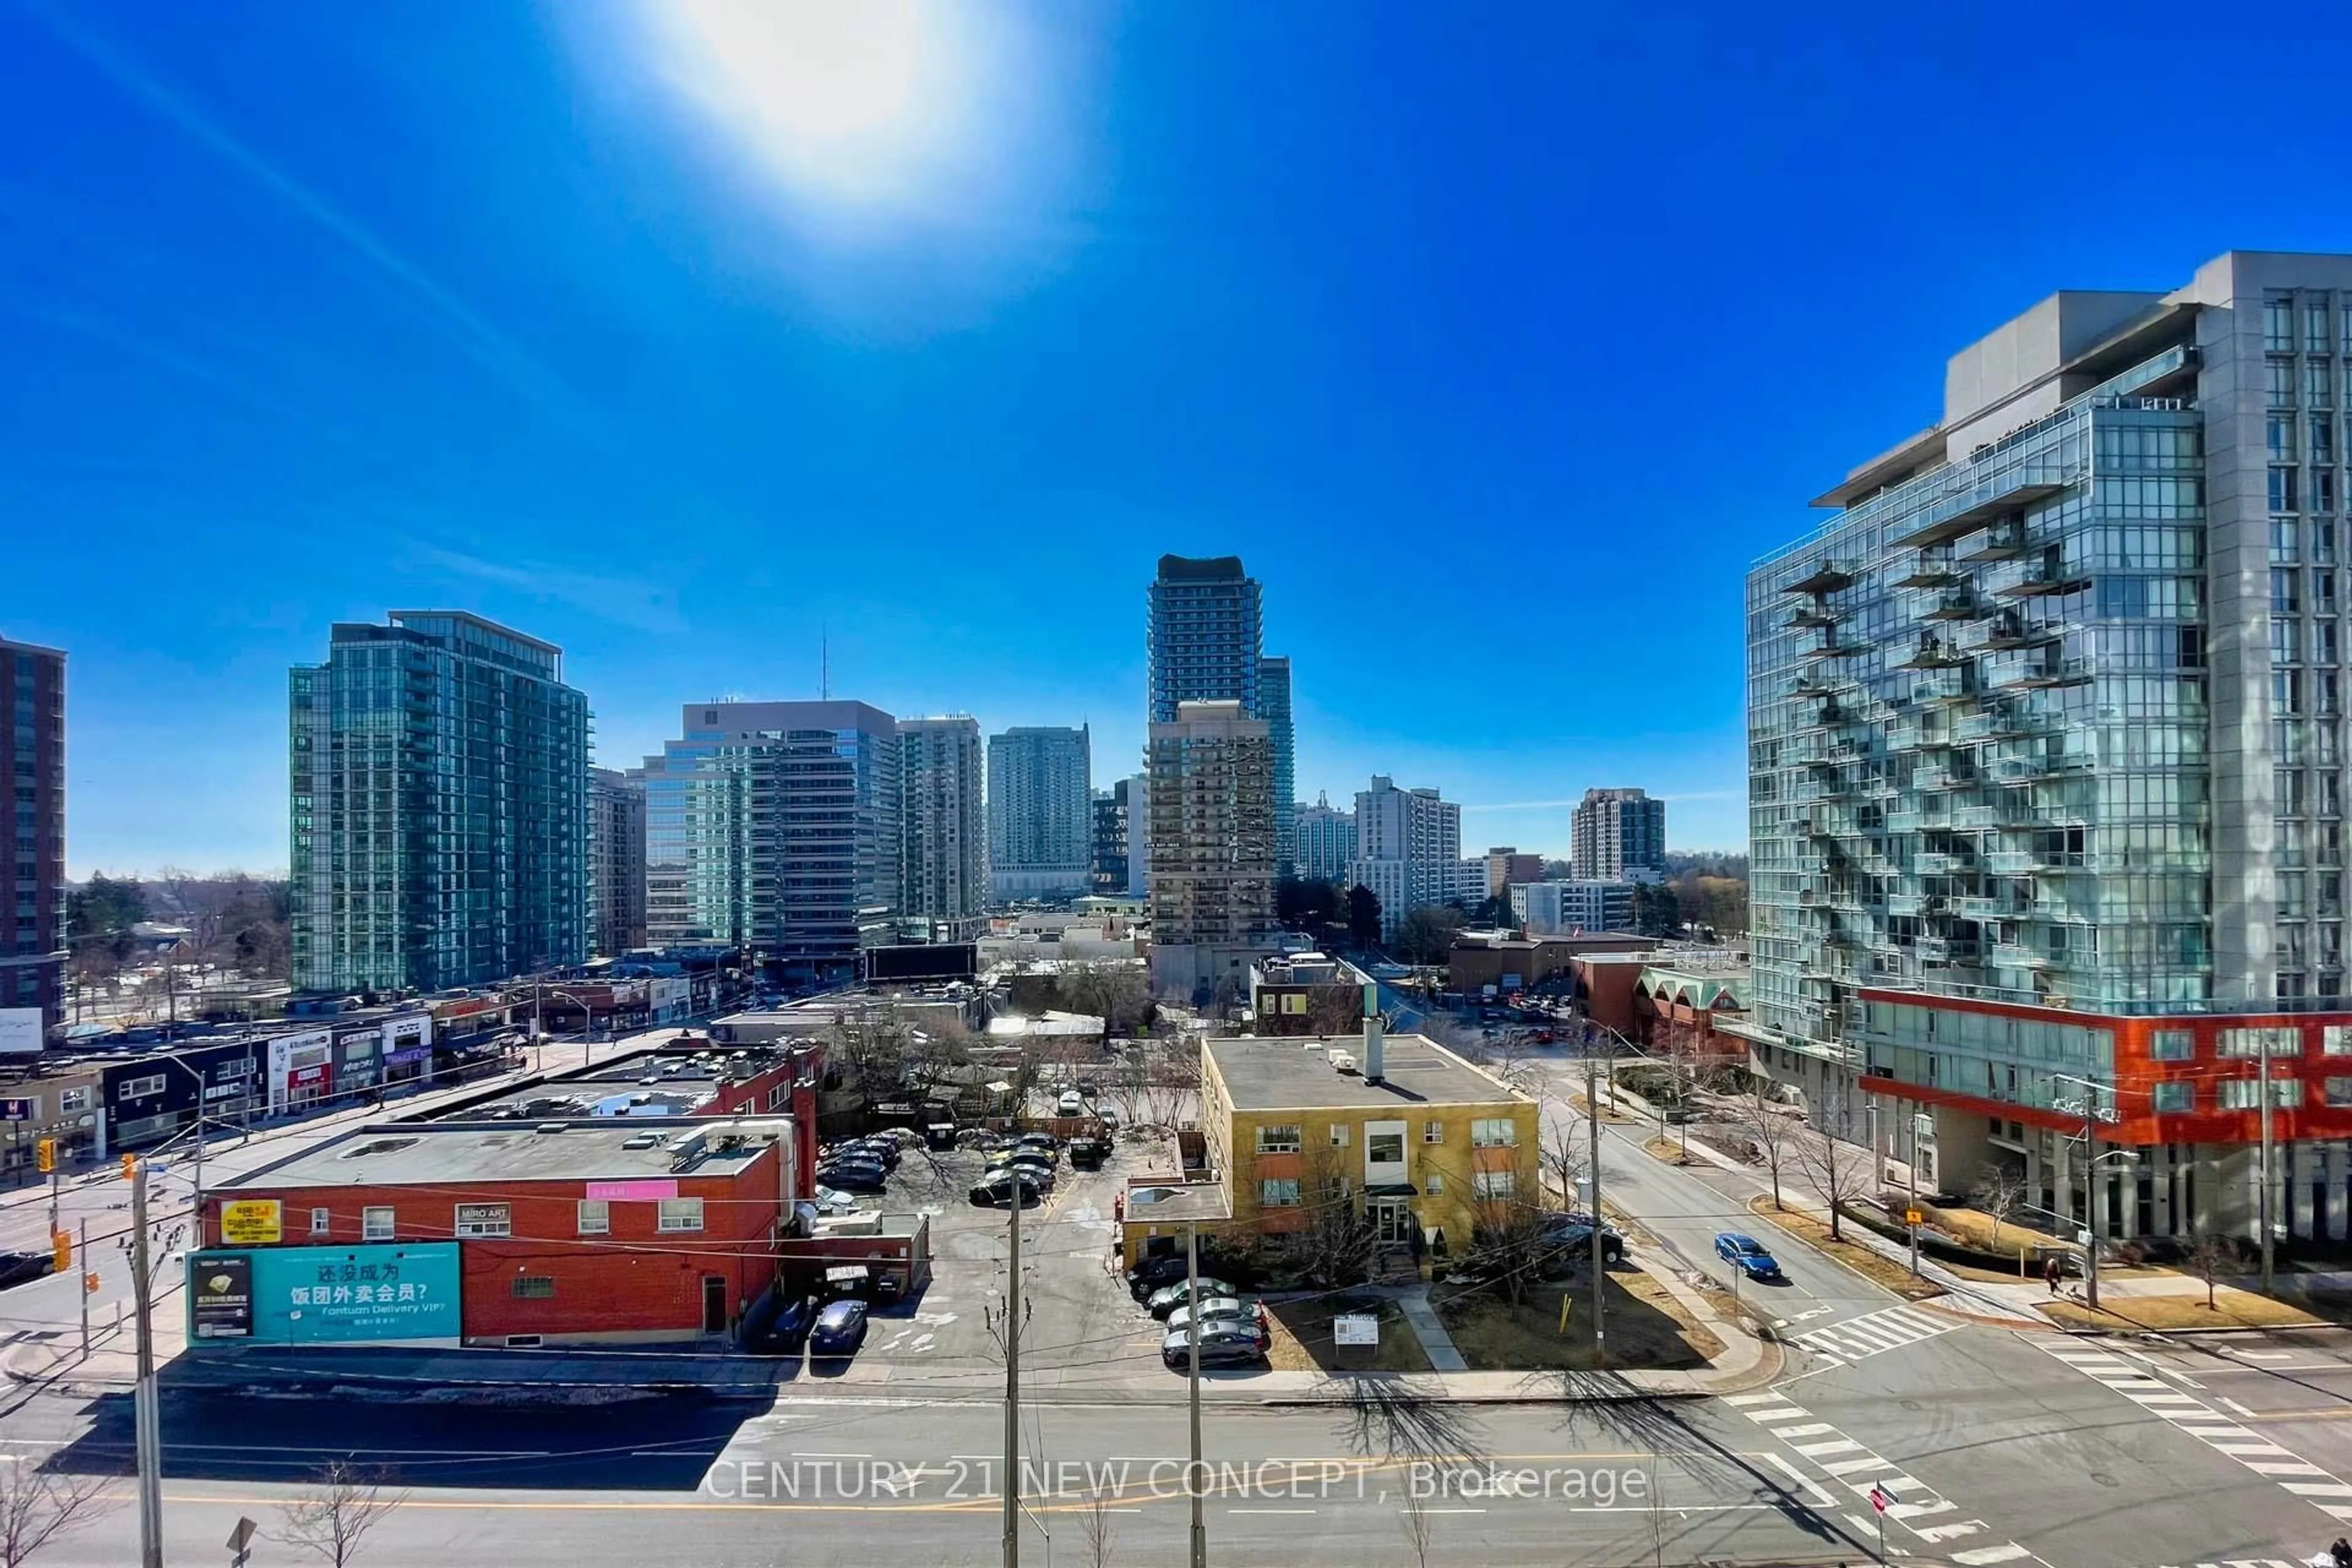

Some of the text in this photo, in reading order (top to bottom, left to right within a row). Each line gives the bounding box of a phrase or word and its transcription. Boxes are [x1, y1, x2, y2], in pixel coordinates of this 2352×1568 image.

[488, 1208, 507, 1218] ART
[318, 1263, 399, 1282] 还没成为
[372, 1304, 419, 1314] Delivery
